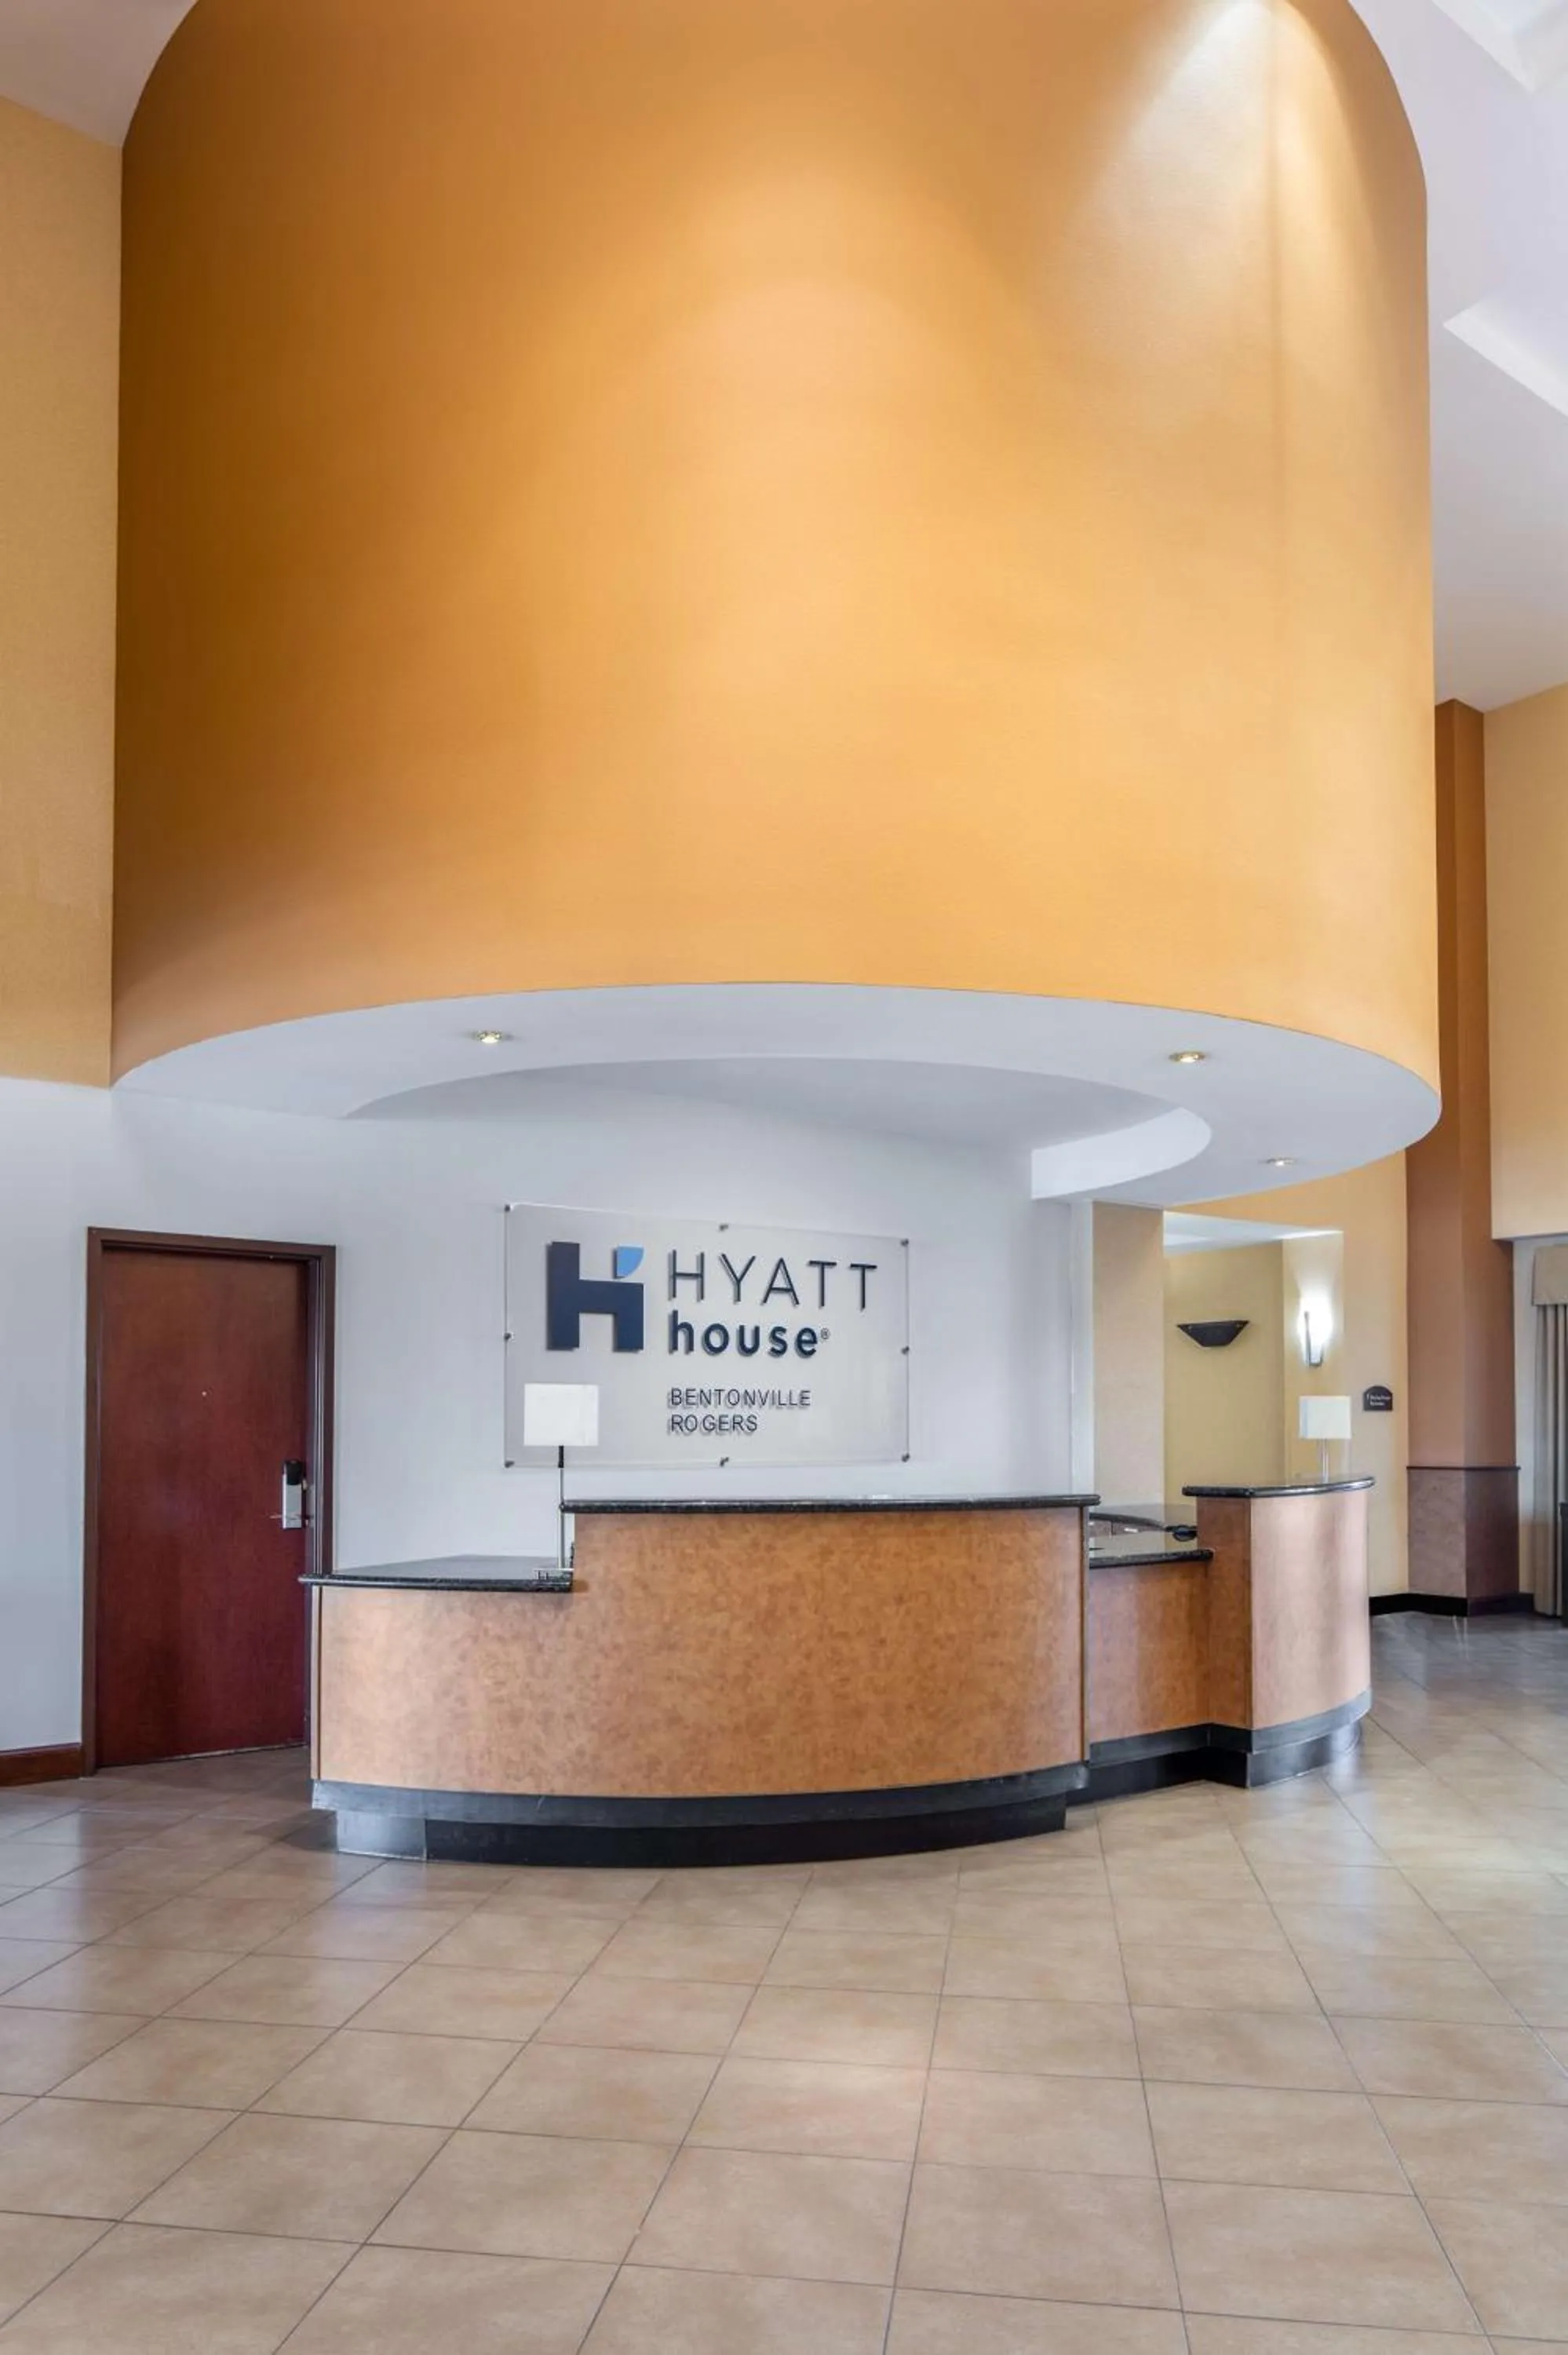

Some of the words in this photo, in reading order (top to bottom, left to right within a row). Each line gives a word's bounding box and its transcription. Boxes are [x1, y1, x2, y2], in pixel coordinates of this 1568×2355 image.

[669, 1250, 877, 1310] HYATT
[669, 1388, 811, 1409] BENTONVILLE
[669, 1414, 758, 1435] ROGERS
